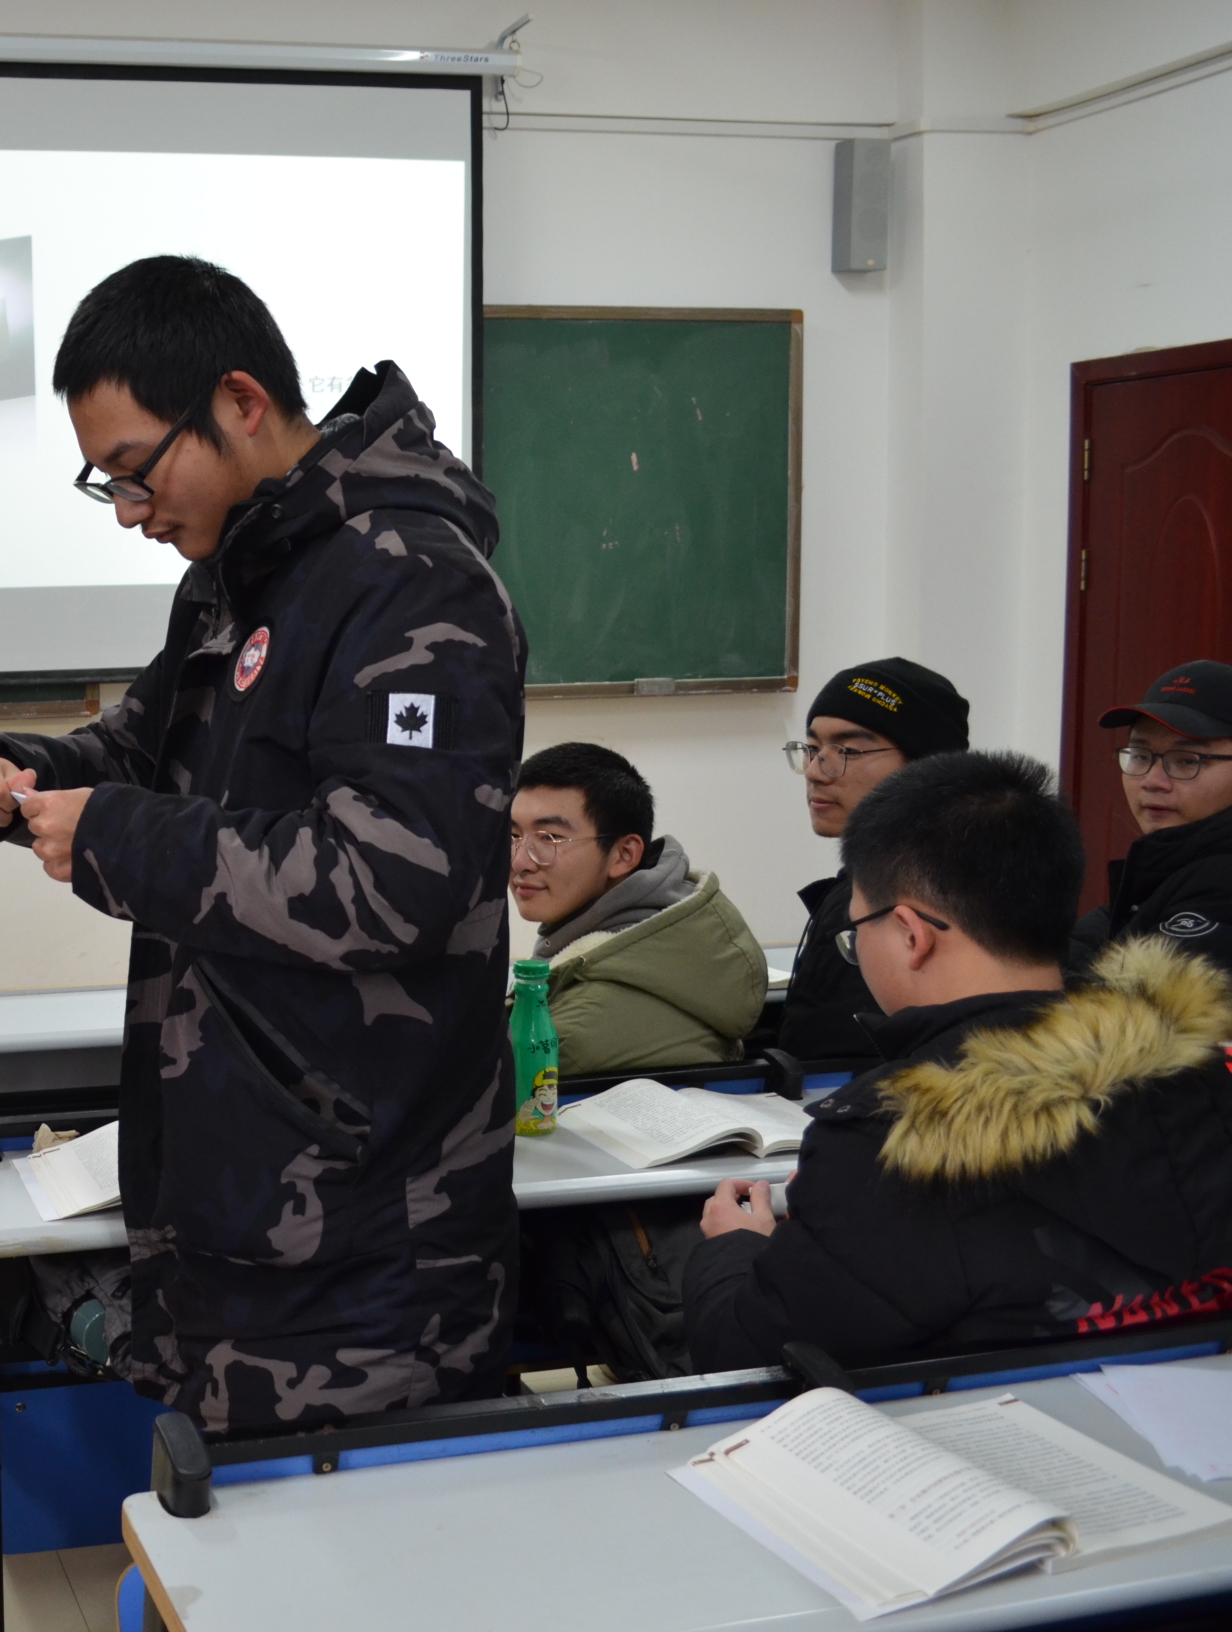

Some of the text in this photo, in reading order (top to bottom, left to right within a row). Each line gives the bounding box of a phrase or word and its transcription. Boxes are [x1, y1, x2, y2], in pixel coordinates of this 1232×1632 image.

[434, 54, 490, 63] ThreeStars
[852, 678, 903, 704] PSYCHO MONKEY
